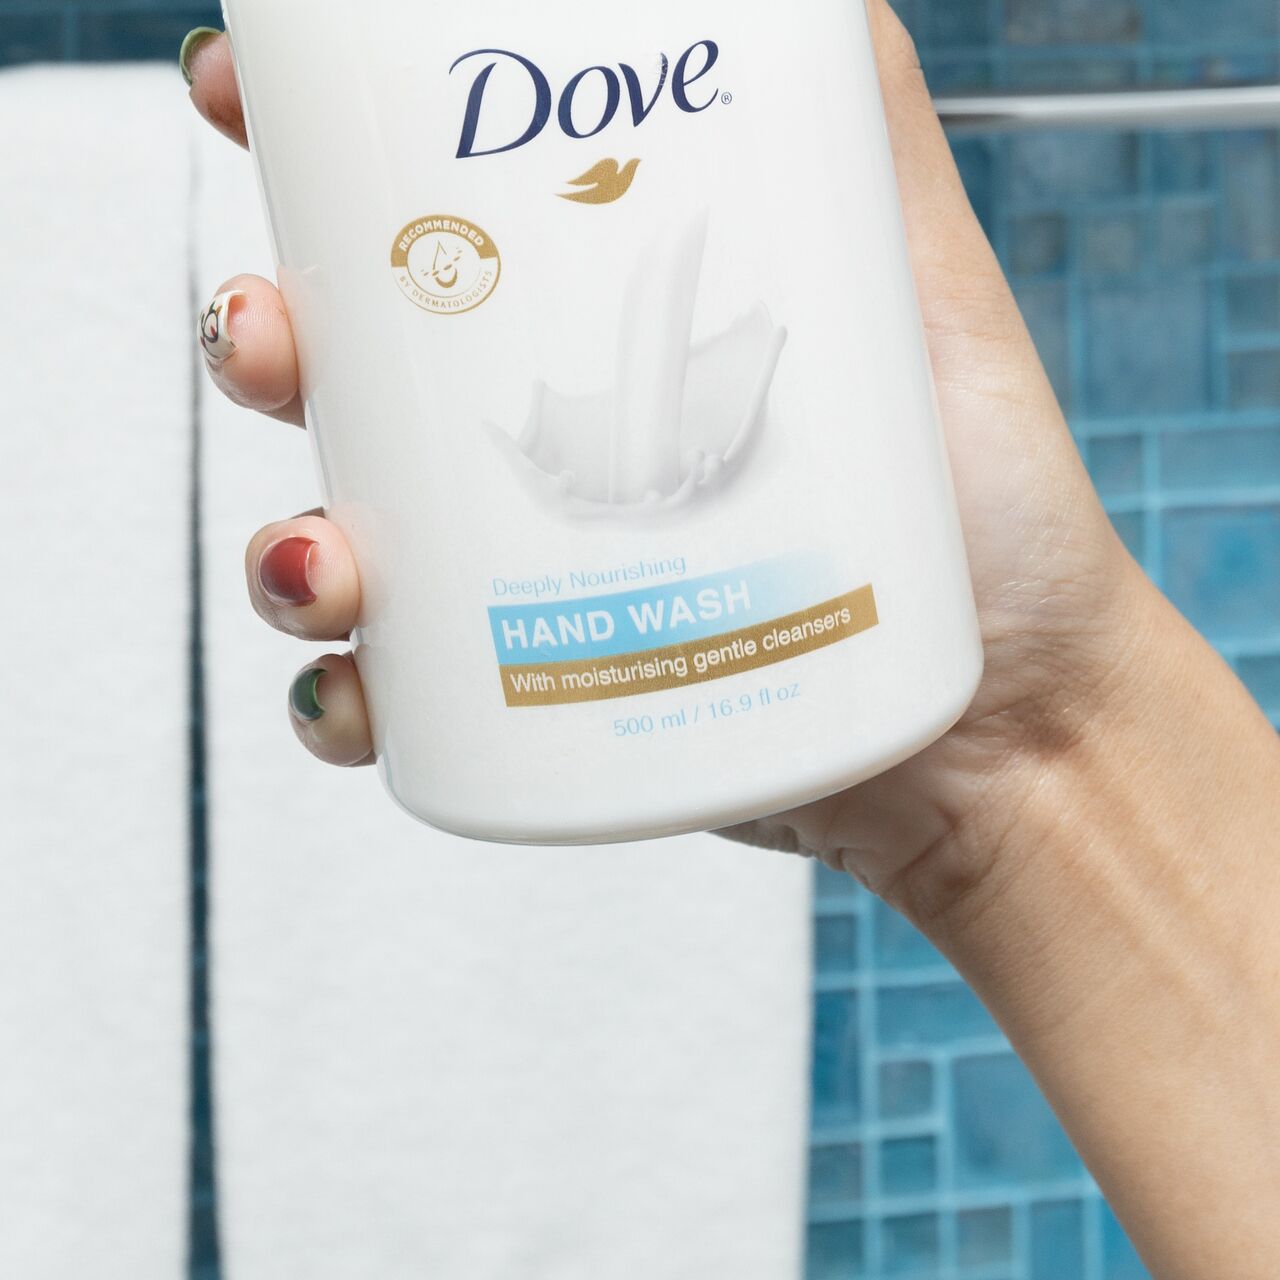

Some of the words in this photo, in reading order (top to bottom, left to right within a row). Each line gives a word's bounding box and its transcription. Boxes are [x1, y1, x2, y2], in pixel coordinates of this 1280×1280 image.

[448, 39, 719, 159] Dove
[398, 219, 484, 251] RECOMMENDED
[412, 270, 493, 309] DERMATOLOGISTS
[492, 573, 562, 599] Deeply
[570, 554, 687, 590] Nourishing
[501, 609, 616, 651] HAND
[627, 580, 752, 636] WASH
[509, 667, 557, 694] With
[561, 649, 689, 691] moisturising
[692, 638, 758, 674] gentle
[762, 605, 852, 653] cleansers
[613, 714, 654, 738] 500
[660, 708, 687, 731] ml
[693, 703, 702, 725] /
[708, 696, 753, 721] 16.9
[758, 687, 772, 707] fl
[776, 682, 801, 702] oz
